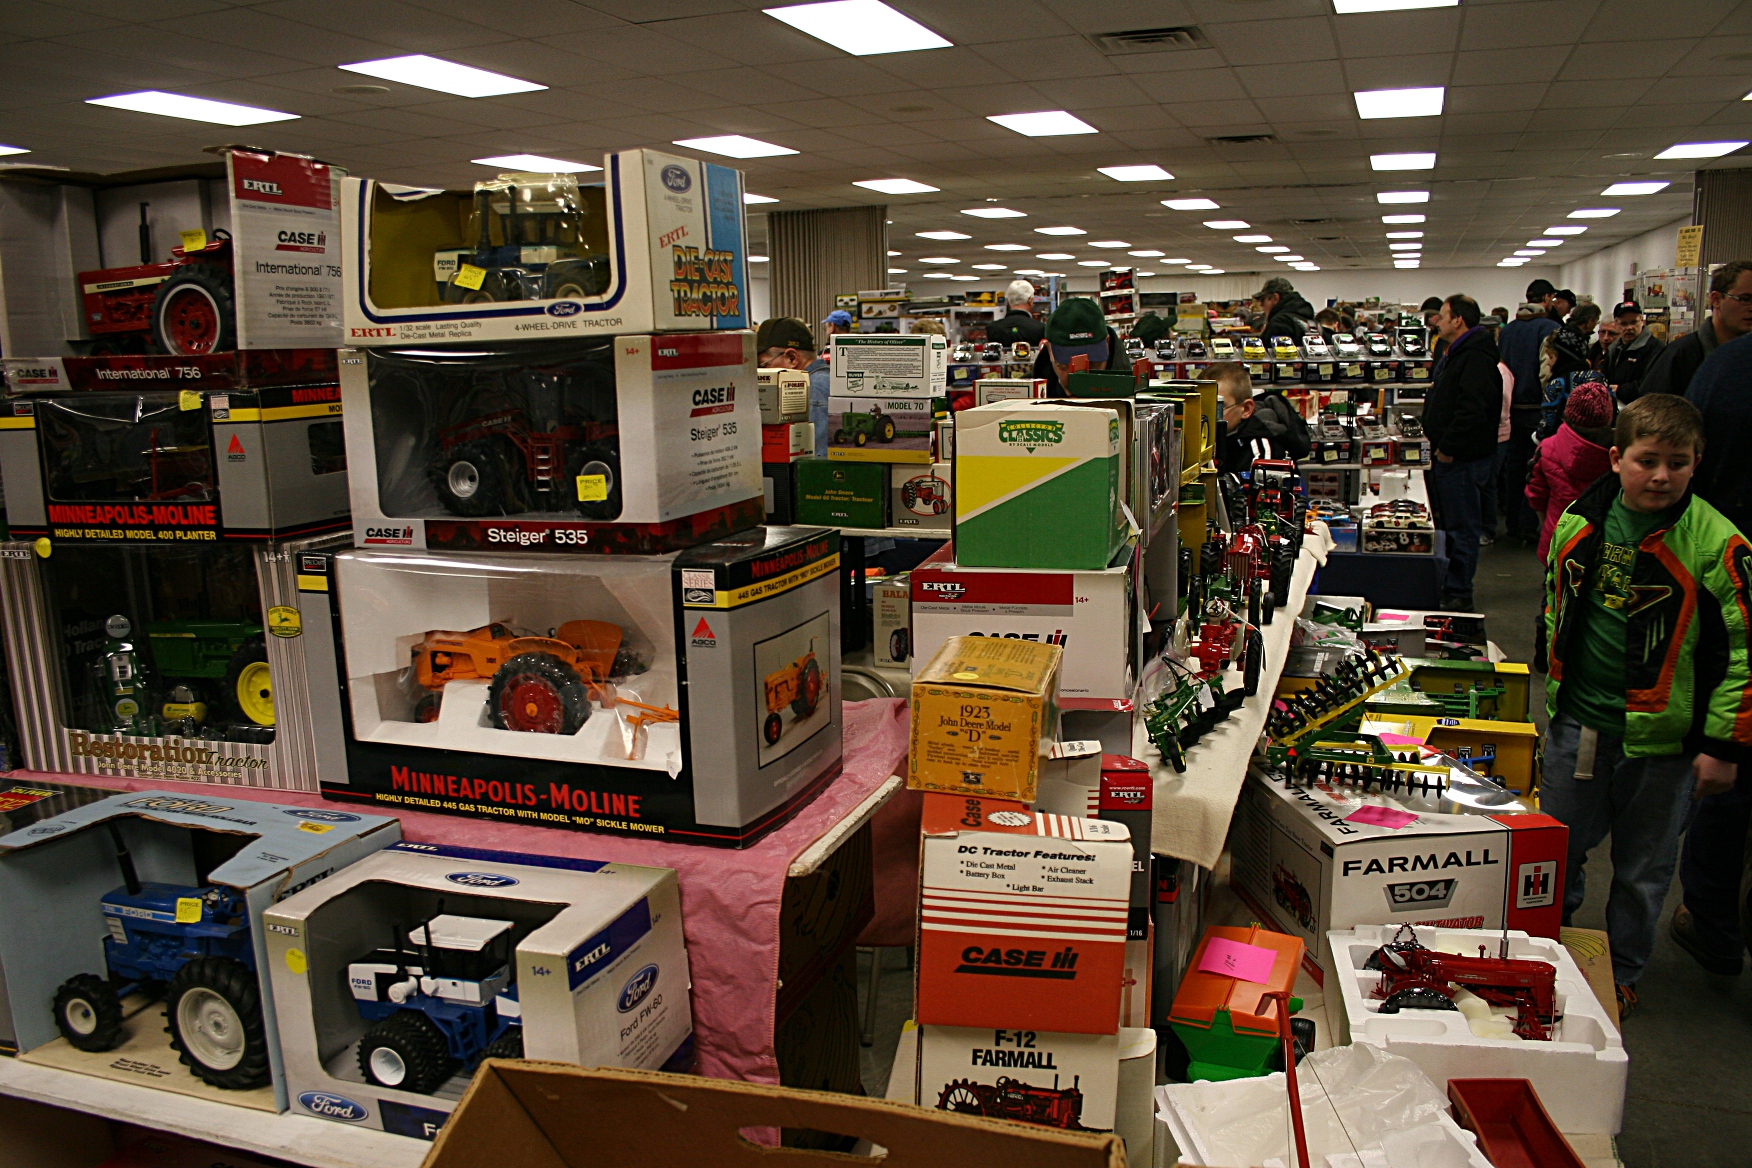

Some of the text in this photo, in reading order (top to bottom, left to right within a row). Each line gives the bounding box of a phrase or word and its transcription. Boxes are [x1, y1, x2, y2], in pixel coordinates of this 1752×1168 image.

[667, 169, 686, 189] Ford
[243, 179, 283, 196] ERTL
[278, 230, 316, 244] CASE
[659, 226, 688, 249] ERTL
[256, 262, 341, 277] International 756
[673, 245, 734, 283] DIE-CAST
[670, 280, 740, 317] TRACTOR
[553, 303, 575, 315] Ford
[400, 321, 482, 332] 1/32 scale Lasting Quality
[514, 318, 622, 332] 4-WHEEL-DRIVE TRACTOR
[351, 327, 397, 338] ERTL
[400, 330, 472, 340] Die-Cast Metal Replica
[625, 348, 639, 356] 14+
[658, 348, 679, 357] ERTL
[839, 347, 847, 356] T
[17, 369, 47, 378] CASE
[96, 366, 201, 380] International 756
[692, 387, 725, 406] CASE
[887, 402, 924, 410] MODEL 70
[690, 422, 738, 442] Steiger 535
[1007, 423, 1056, 431] COLLECTOR
[998, 428, 1063, 444] CLASSICS
[49, 505, 216, 525] MINNEAPOLIS-MOLINE
[54, 528, 217, 540] HIGHLY DETAILED MODEL 400 PLANTER
[366, 528, 400, 538] CASE
[487, 528, 588, 546] Steiger 535
[1399, 533, 1409, 545] 8
[263, 551, 283, 563] 14+
[751, 540, 829, 578] MINNEAPOLIS-MOLINE
[683, 571, 714, 581] CLASSIC
[738, 558, 837, 600] 445 GAS TRACTOR WITH SICKLE MOWER
[683, 579, 714, 588] SERIES
[922, 582, 966, 593] ERTL
[883, 590, 909, 599] BALA
[960, 704, 991, 719] 1923
[938, 715, 1011, 732] John Deere Model
[70, 733, 269, 770] Restoration Tractor
[98, 761, 242, 778] John Deere Model 4020 & Accessories
[1110, 791, 1145, 799] ERTL
[375, 792, 665, 834] HIGHLY DETAILED 445 GAS TRACTOR WITH MODEL SICKLE MOWER
[961, 799, 982, 828] Case
[396, 842, 438, 851] ERTL
[957, 845, 1096, 862] DC Tractor Features:
[966, 860, 1016, 871] Die Cast Metal
[1342, 848, 1499, 877] FARMALL
[966, 870, 1006, 880] Battery Box
[1060, 867, 1087, 875] Cleaner
[457, 873, 505, 887] Ford
[1047, 876, 1094, 885] Exhaust Stack
[1012, 884, 1031, 894] Light
[1394, 882, 1447, 902] 504
[652, 913, 662, 926] 14+
[268, 923, 299, 937] ERTL
[575, 942, 611, 973] ERTL
[961, 946, 1047, 968] CASE
[530, 965, 552, 977] 14+
[625, 971, 651, 1008] Ford
[620, 1016, 638, 1042] Ford
[640, 993, 663, 1023] FW-60
[995, 1030, 1037, 1048] F-12
[972, 1049, 1058, 1070] FARMALL
[311, 1094, 354, 1119] Ford
